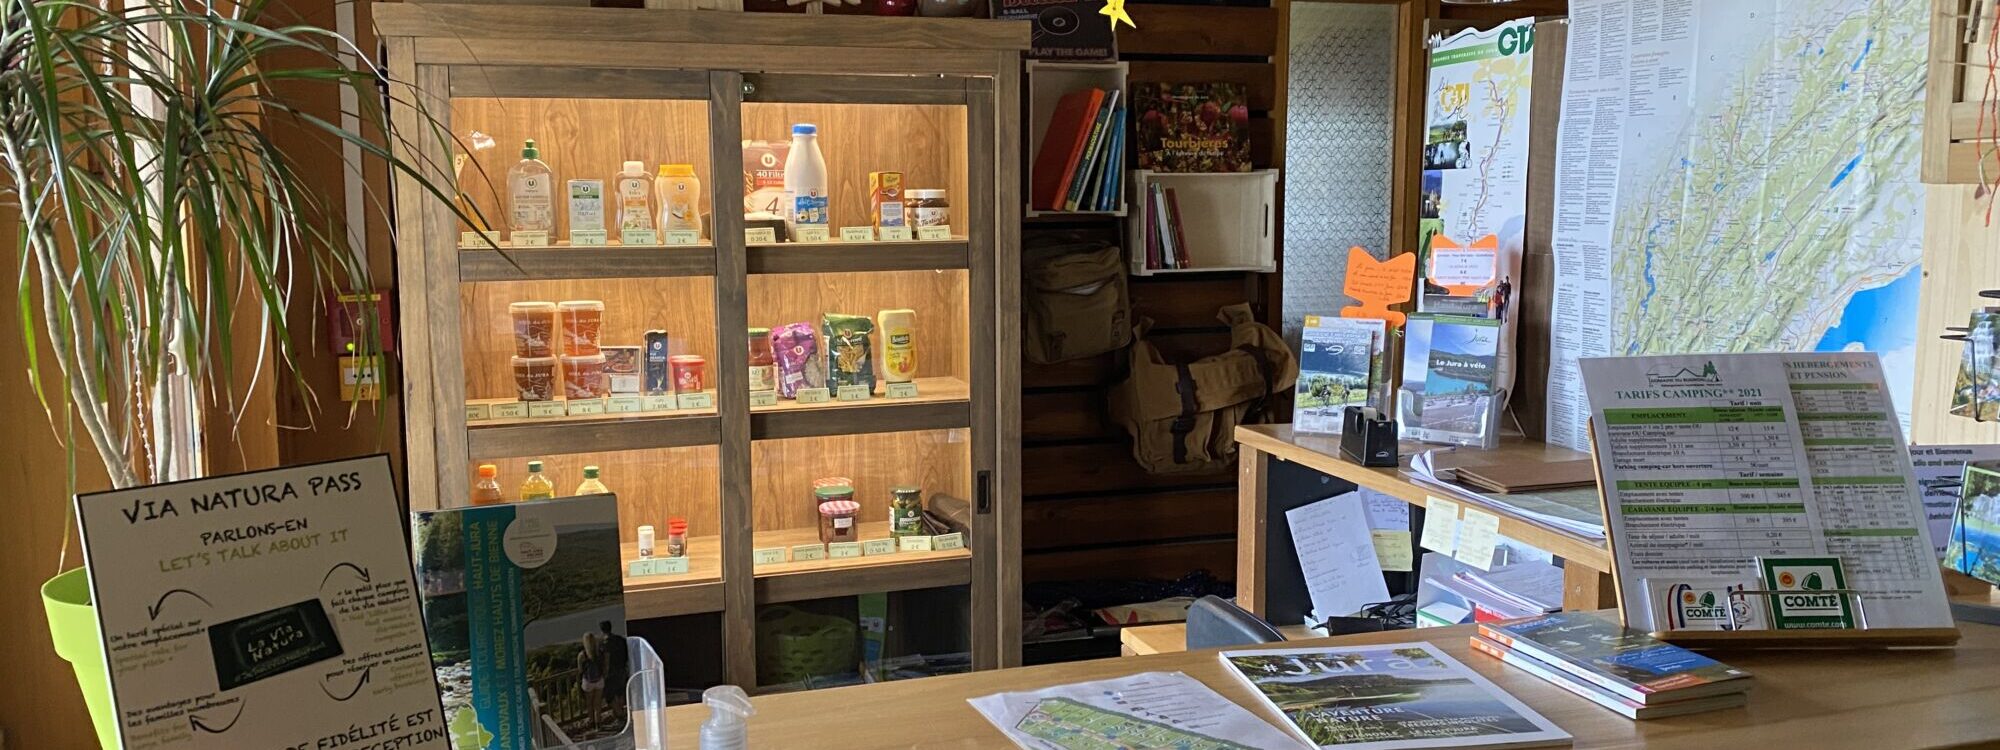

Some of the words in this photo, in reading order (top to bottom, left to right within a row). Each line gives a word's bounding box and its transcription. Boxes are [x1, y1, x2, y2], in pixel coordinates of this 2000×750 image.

[1029, 47, 1053, 57] PLAY
[1054, 47, 1074, 57] THE
[1075, 48, 1108, 57] GAME!
[765, 197, 780, 215] 4
[1470, 361, 1486, 369] vélo
[1805, 371, 1848, 379] PENSION
[1615, 390, 1660, 400] TARIFS
[1738, 388, 1762, 397] 2021
[1910, 449, 1923, 457] jour
[123, 499, 179, 525] VIA
[190, 483, 299, 514] NATURA
[307, 472, 363, 497] PASS
[200, 518, 308, 546] PARLONS-EN
[486, 520, 499, 563] BIENNE
[159, 552, 210, 573] LET'S
[217, 543, 262, 565] TALK
[268, 534, 320, 554] ABOUT
[329, 529, 349, 545] IT
[469, 521, 483, 589] HAUT-JURA
[488, 564, 500, 582] DE
[490, 584, 503, 625] HAUTS
[1784, 594, 1839, 607] COMTÉ
[1686, 607, 1727, 618] COMTÉ
[493, 627, 506, 670] MOREZ
[478, 673, 491, 709] GUIDE
[498, 691, 512, 750] ANDVAUX
[1307, 707, 1405, 718] L'AVENTURE
[1316, 714, 1382, 724] NATURE
[286, 742, 309, 750] E
[317, 713, 400, 750] FIDÉLITÉ
[407, 709, 433, 727] EST
[359, 726, 443, 750] CEPTION
